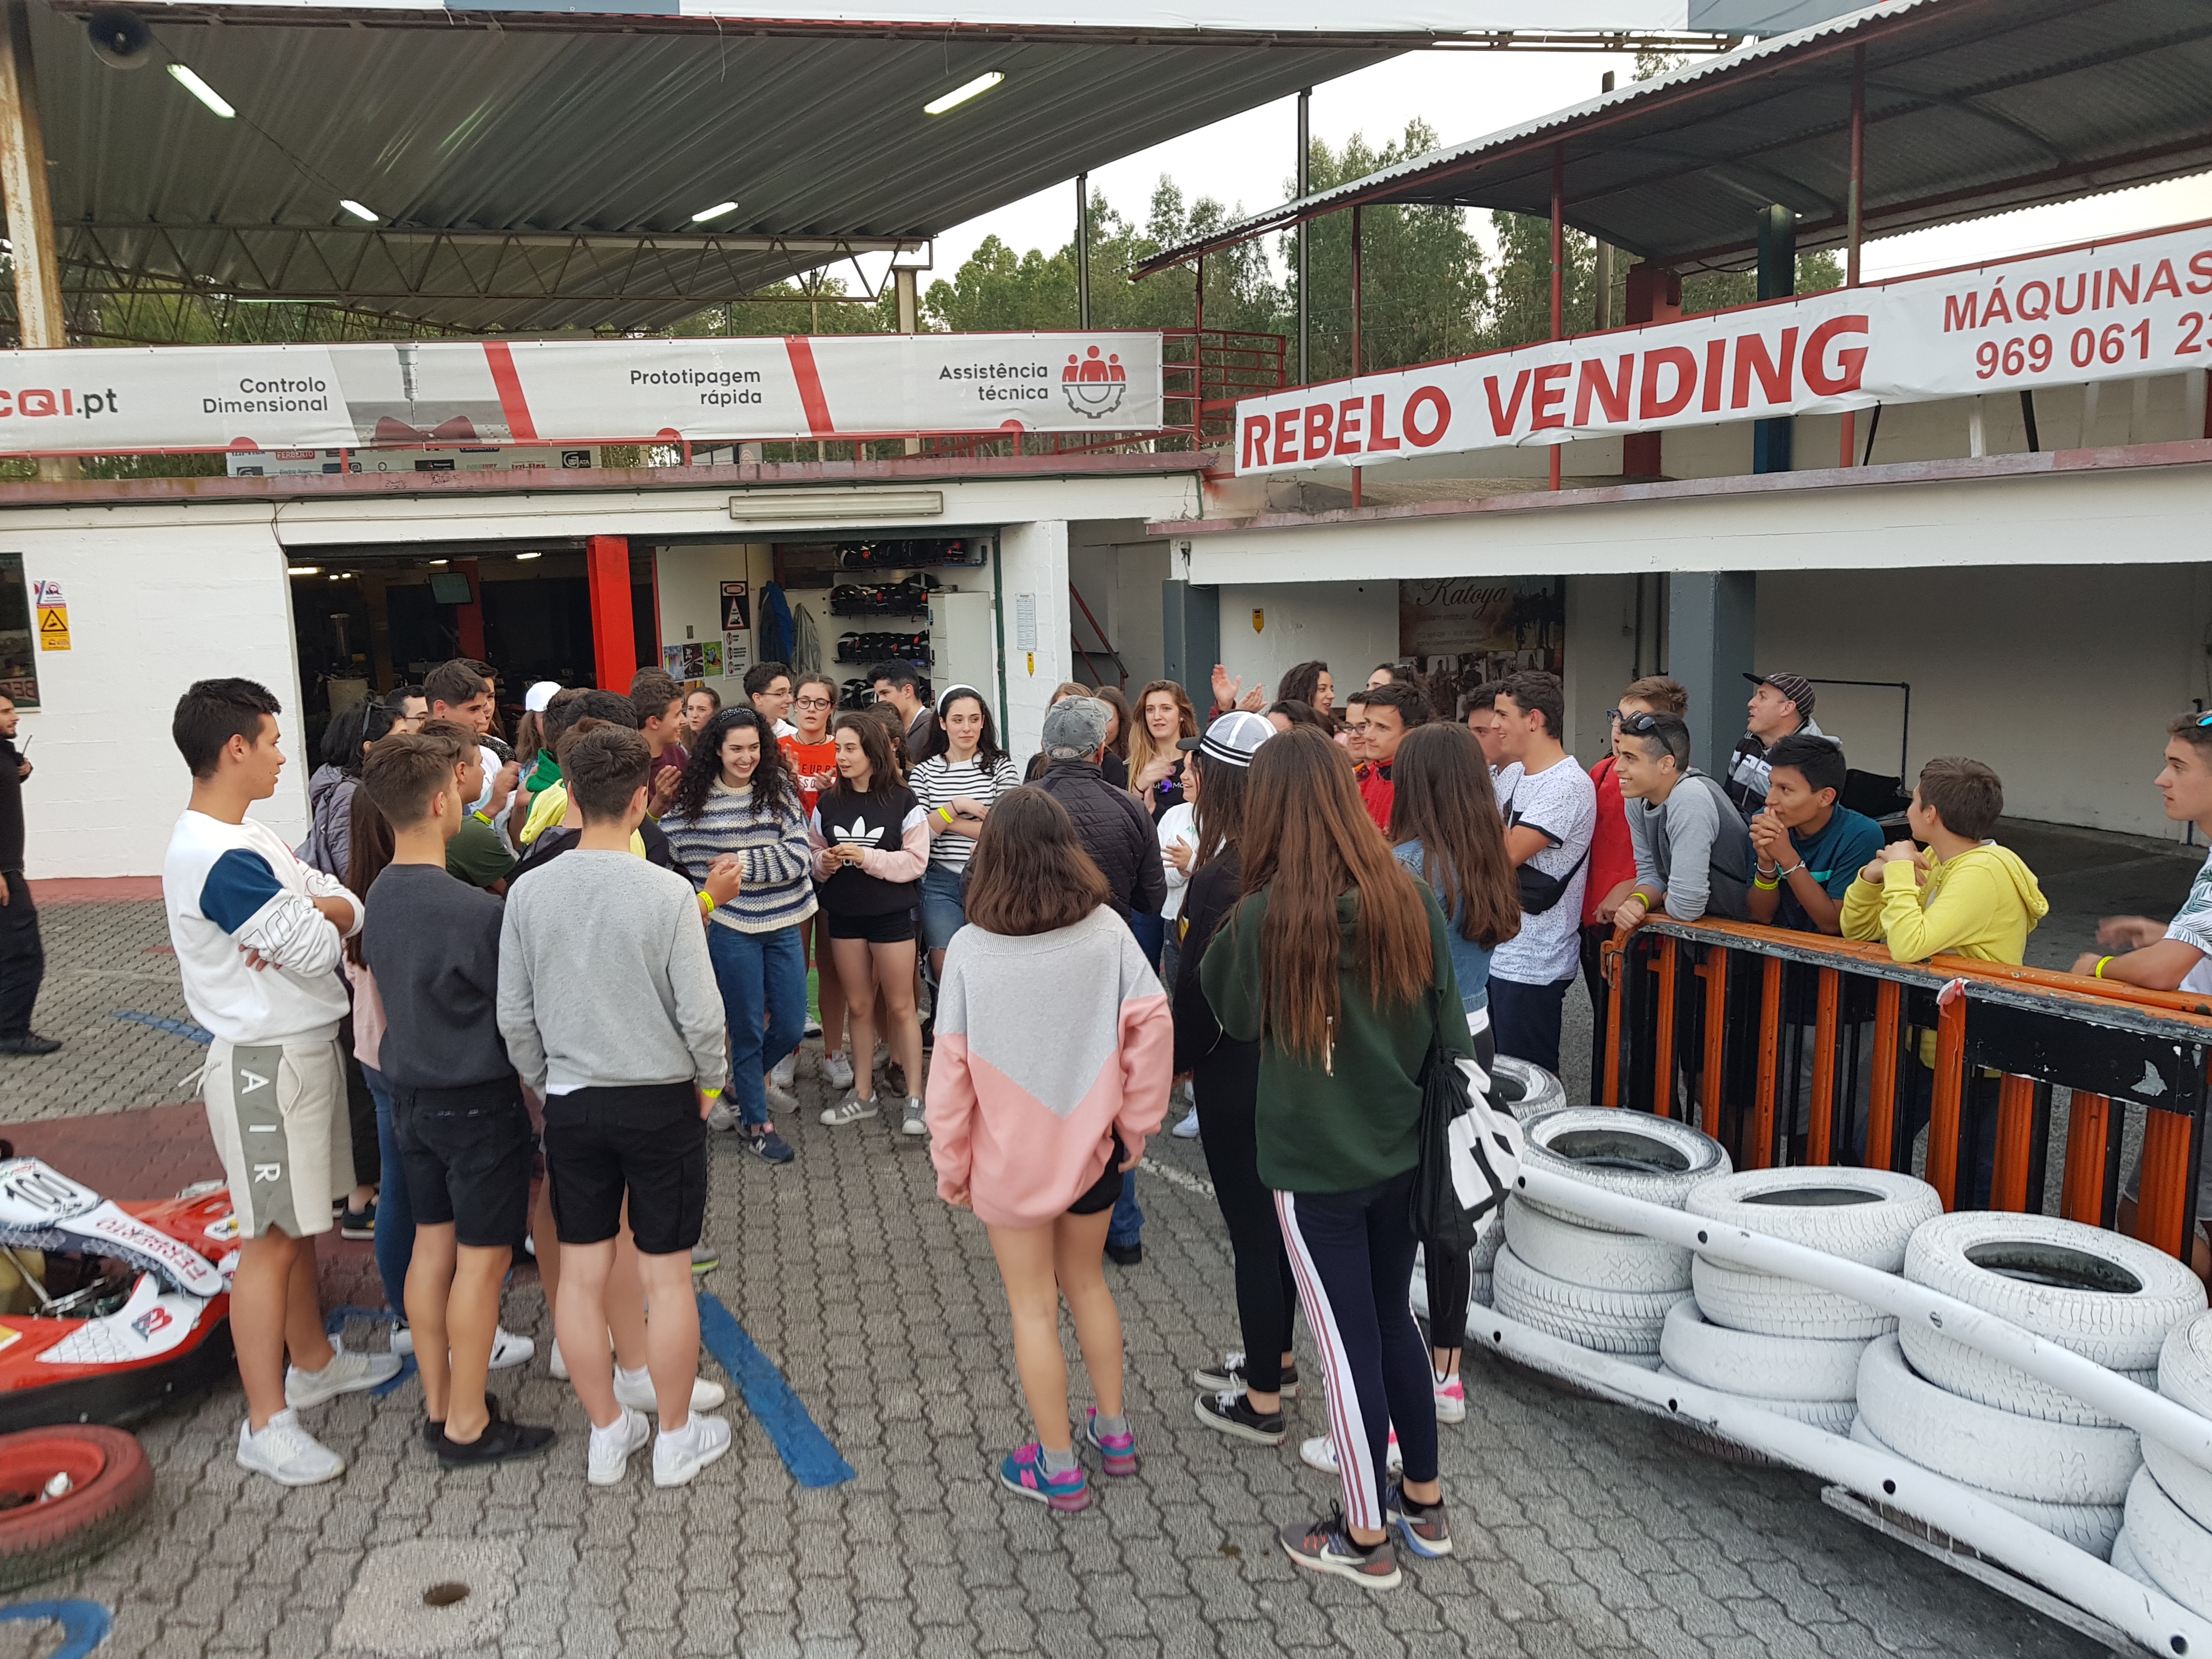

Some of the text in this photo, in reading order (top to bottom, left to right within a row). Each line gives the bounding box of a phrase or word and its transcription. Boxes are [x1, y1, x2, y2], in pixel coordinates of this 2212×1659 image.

[1943, 250, 2212, 332] MÁQUINAS
[1976, 311, 2212, 379] 969 061 2
[630, 369, 761, 388] Prototipagem
[939, 363, 1048, 380] Assistência
[240, 377, 326, 394] Controlo
[978, 385, 1048, 400] técnica
[1242, 315, 1869, 467] REBELO VENDING
[203, 395, 328, 413] Dimensional
[701, 389, 762, 407] rápida
[277, 450, 314, 459] FERBERTO
[240, 1068, 280, 1183] AIR
